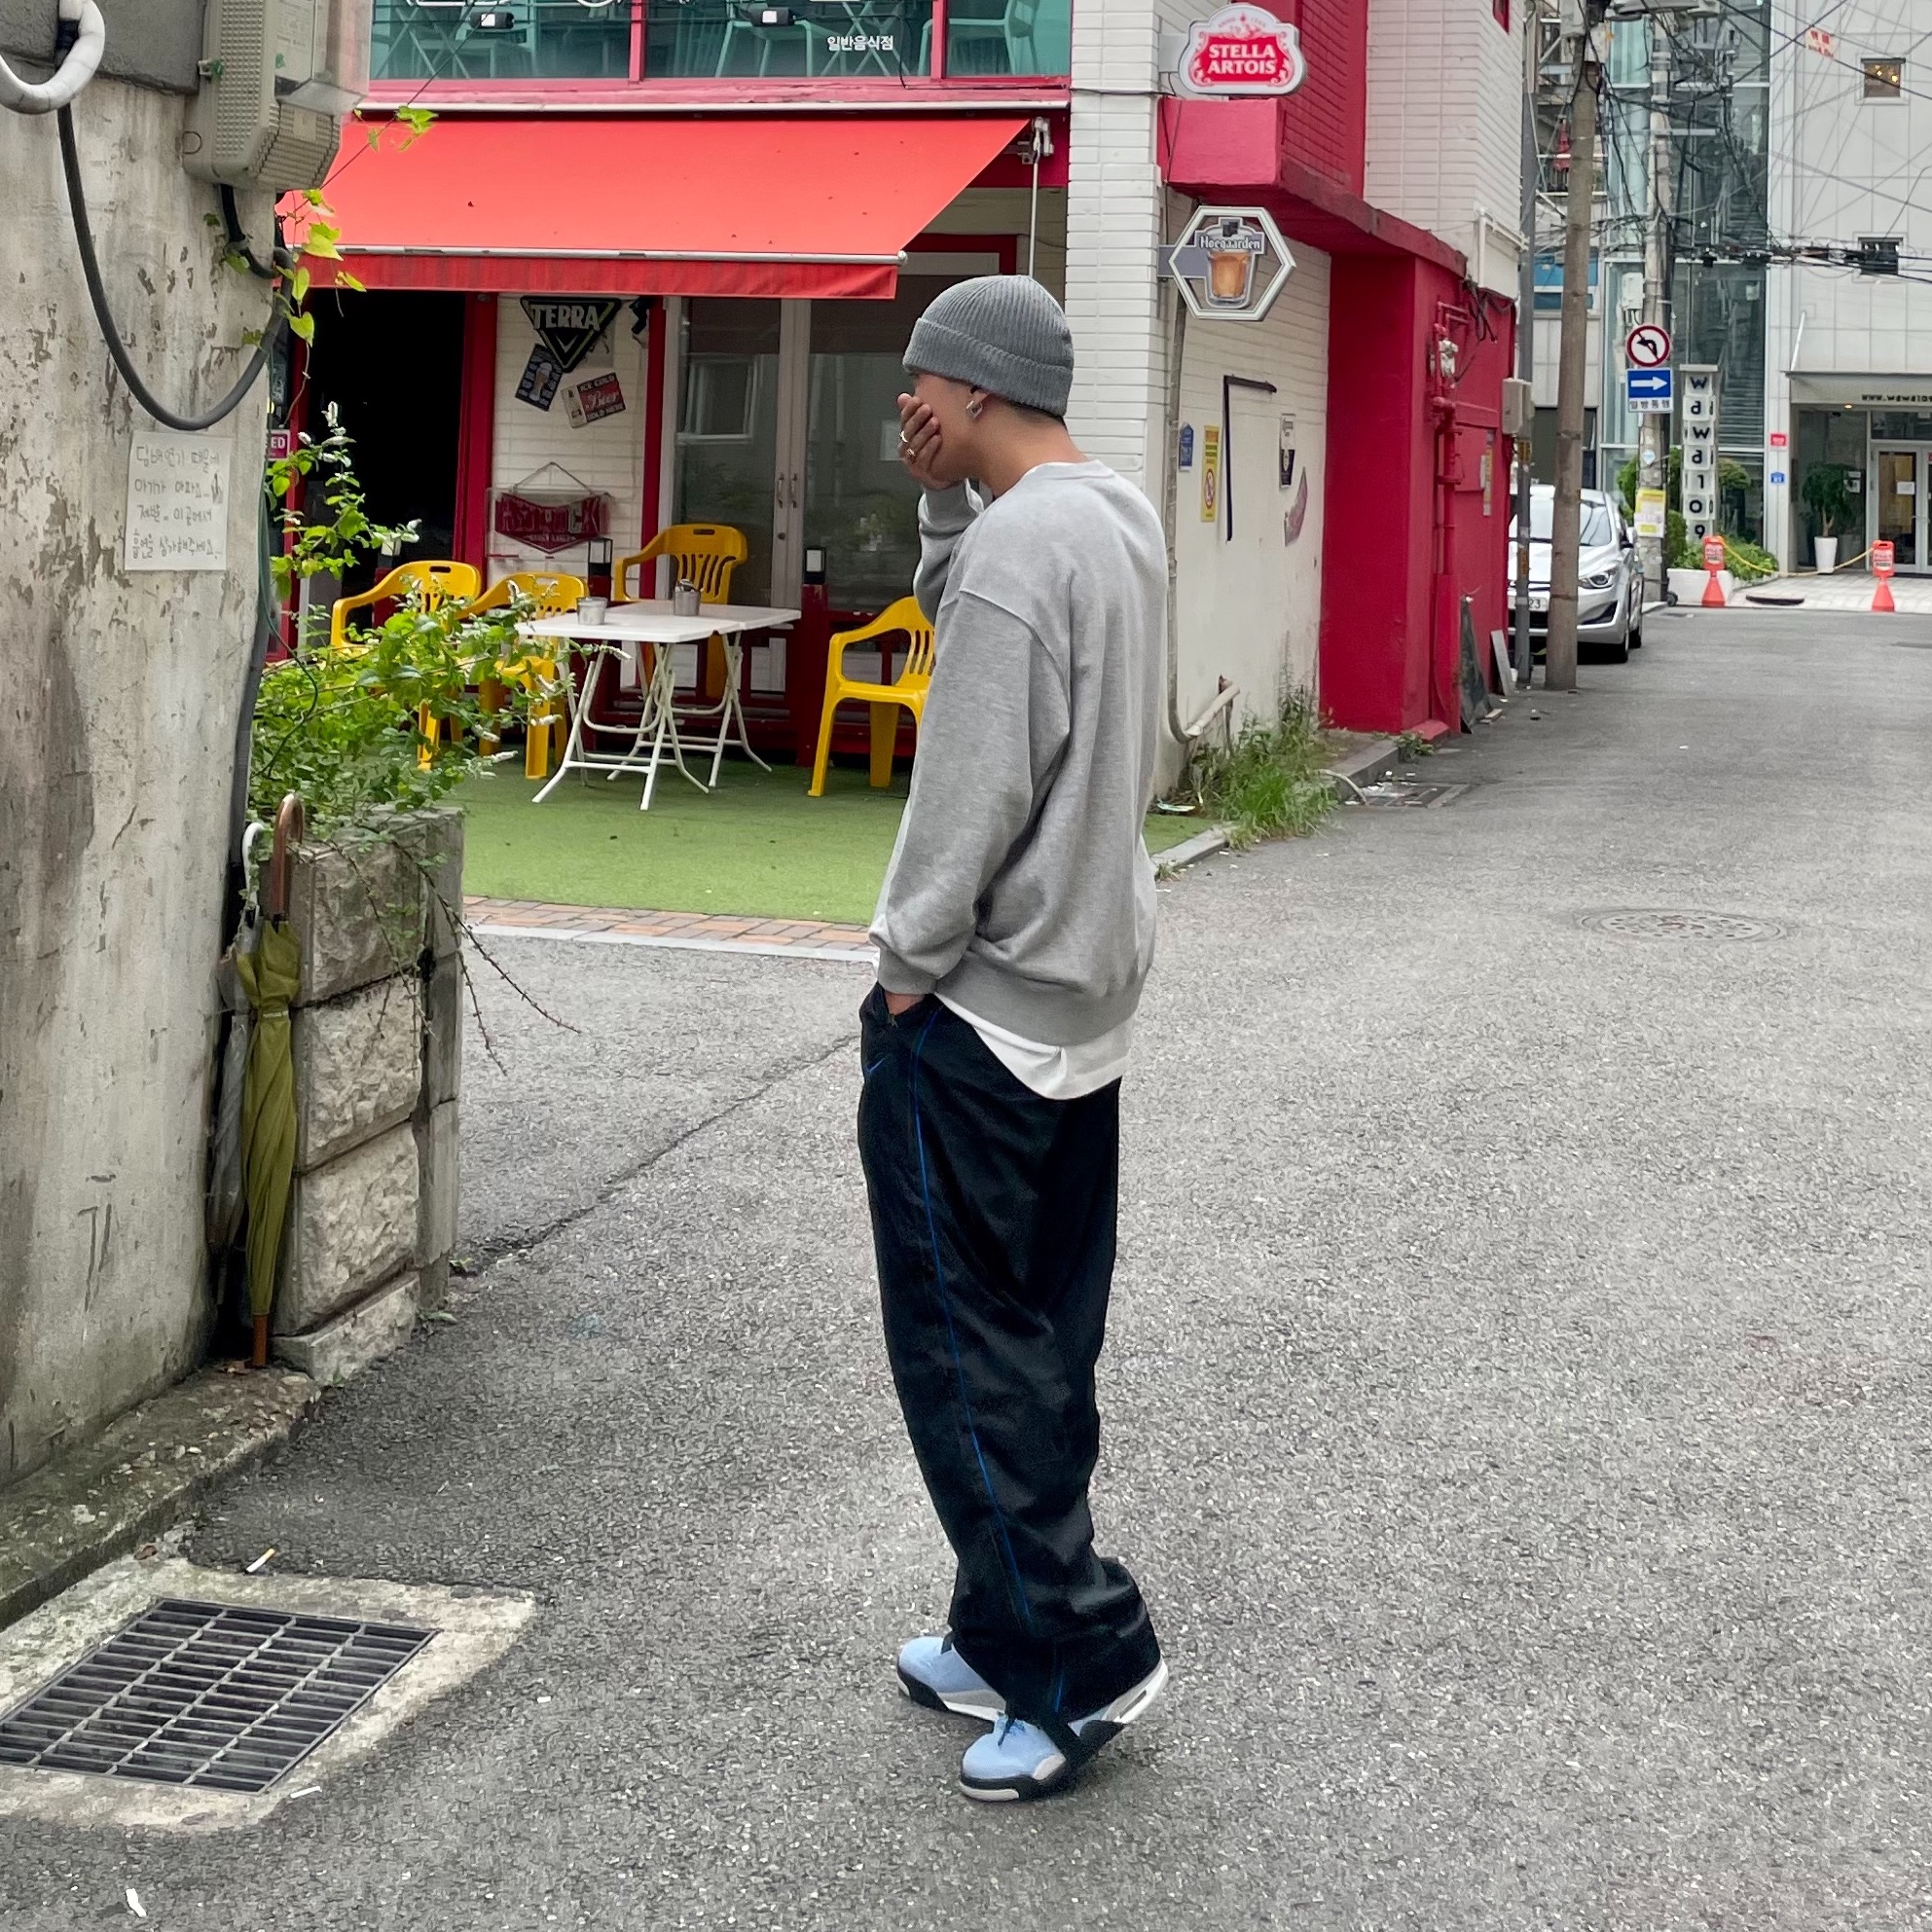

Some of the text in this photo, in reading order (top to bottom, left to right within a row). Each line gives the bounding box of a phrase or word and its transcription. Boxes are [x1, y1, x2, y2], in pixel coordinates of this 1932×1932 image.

[827, 35, 893, 52] 일반음식점
[1208, 43, 1276, 58] STELLA
[1207, 59, 1277, 75] ARTOIS
[1200, 235, 1260, 251] Hoegaarden
[529, 304, 601, 332] TERRA
